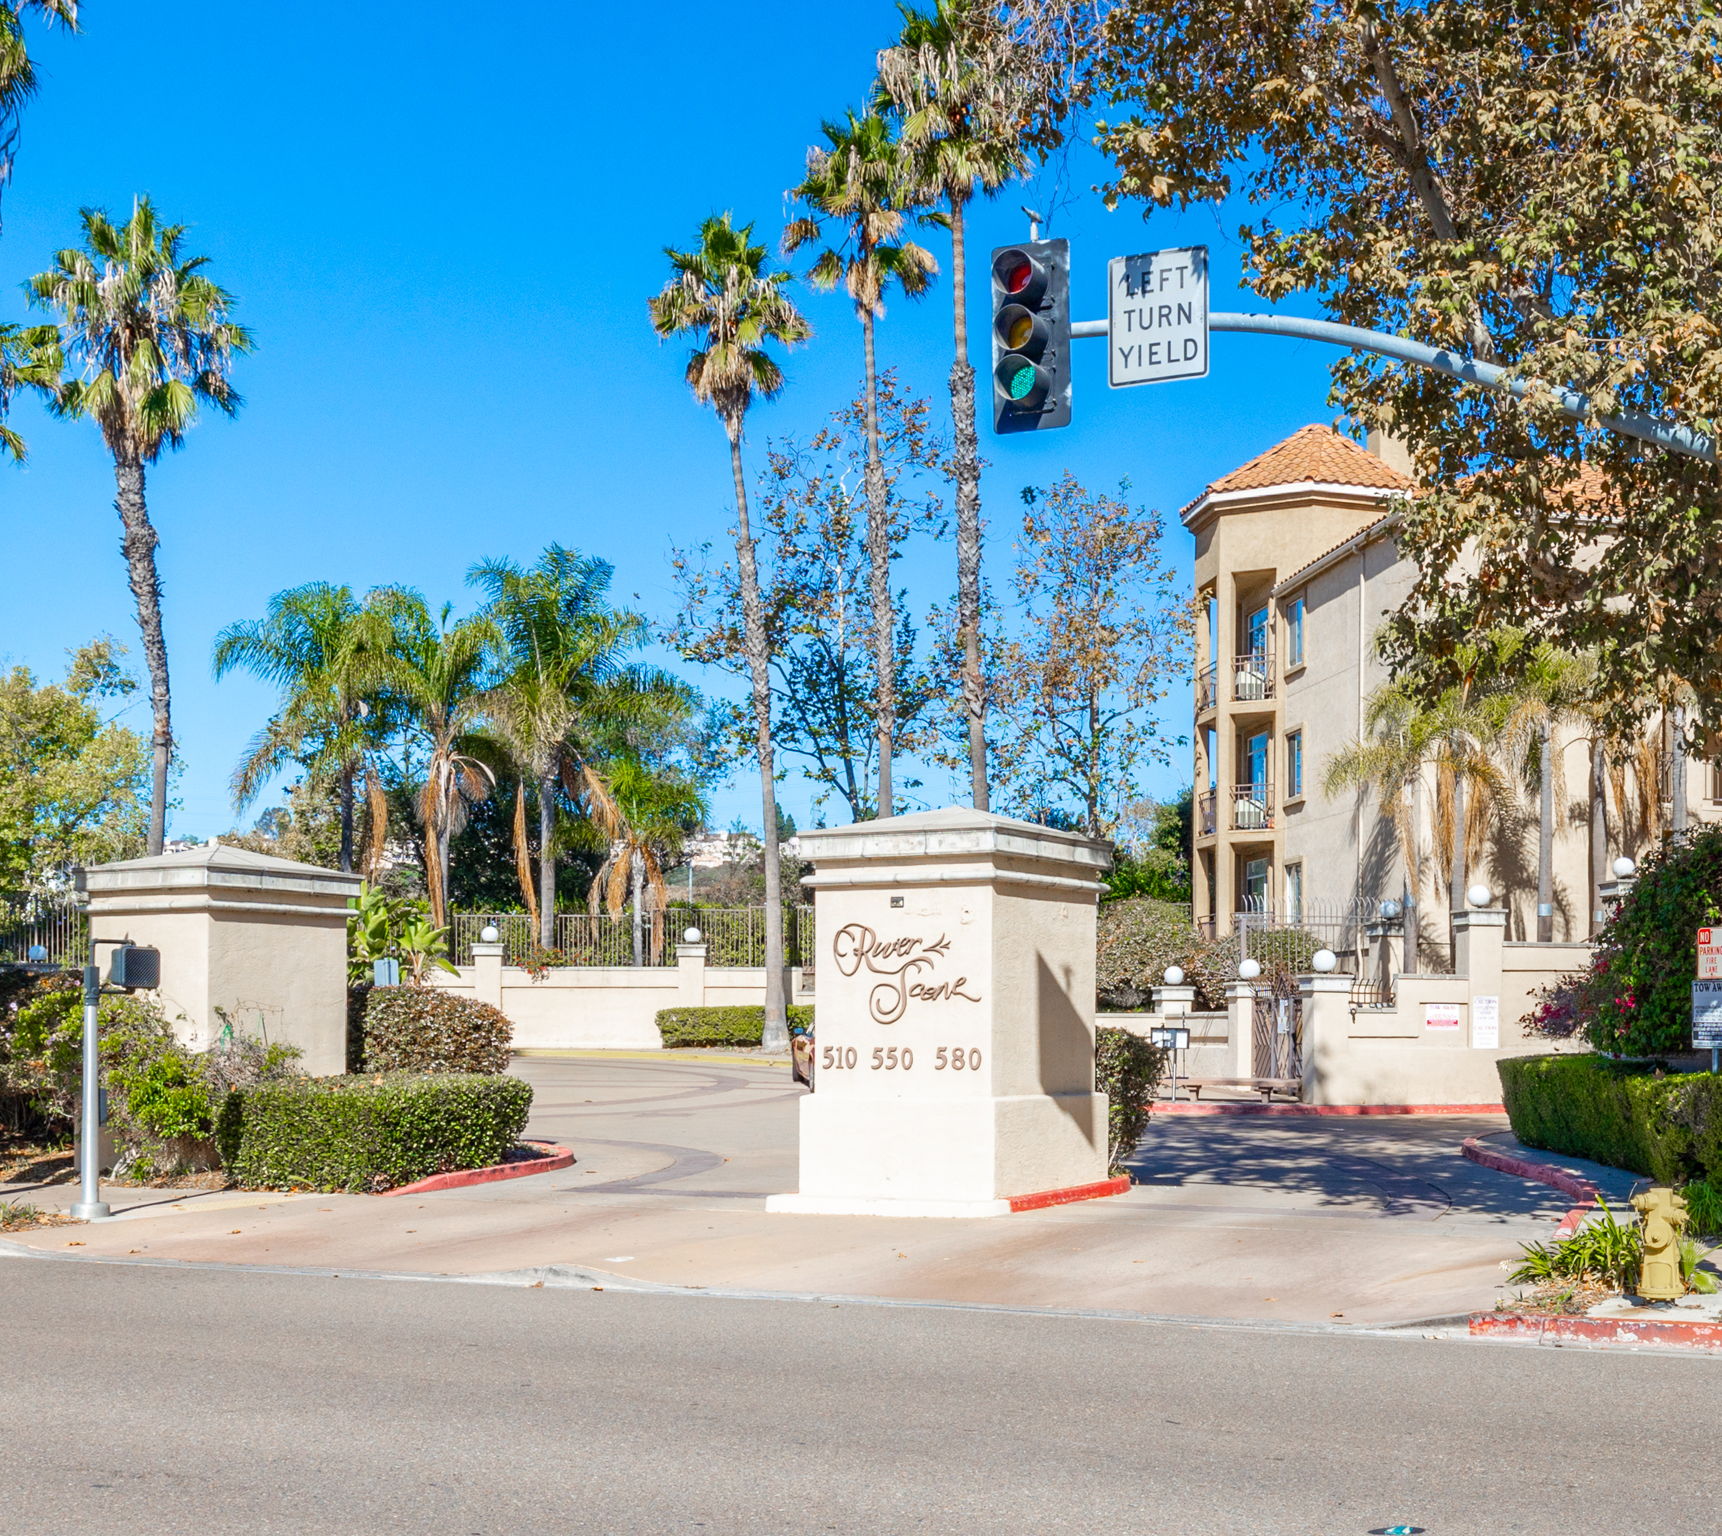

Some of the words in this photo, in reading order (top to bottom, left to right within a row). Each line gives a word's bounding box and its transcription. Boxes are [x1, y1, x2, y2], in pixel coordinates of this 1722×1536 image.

[1126, 266, 1188, 297] LEFT
[1123, 301, 1192, 333] TURN
[1118, 337, 1198, 369] YIELD
[833, 923, 923, 977] River
[1699, 931, 1710, 943] NO
[869, 956, 982, 1025] Scene
[1694, 983, 1711, 992] TOW
[822, 1046, 857, 1070] 510
[870, 1046, 914, 1071] 550
[934, 1046, 982, 1071] 580
